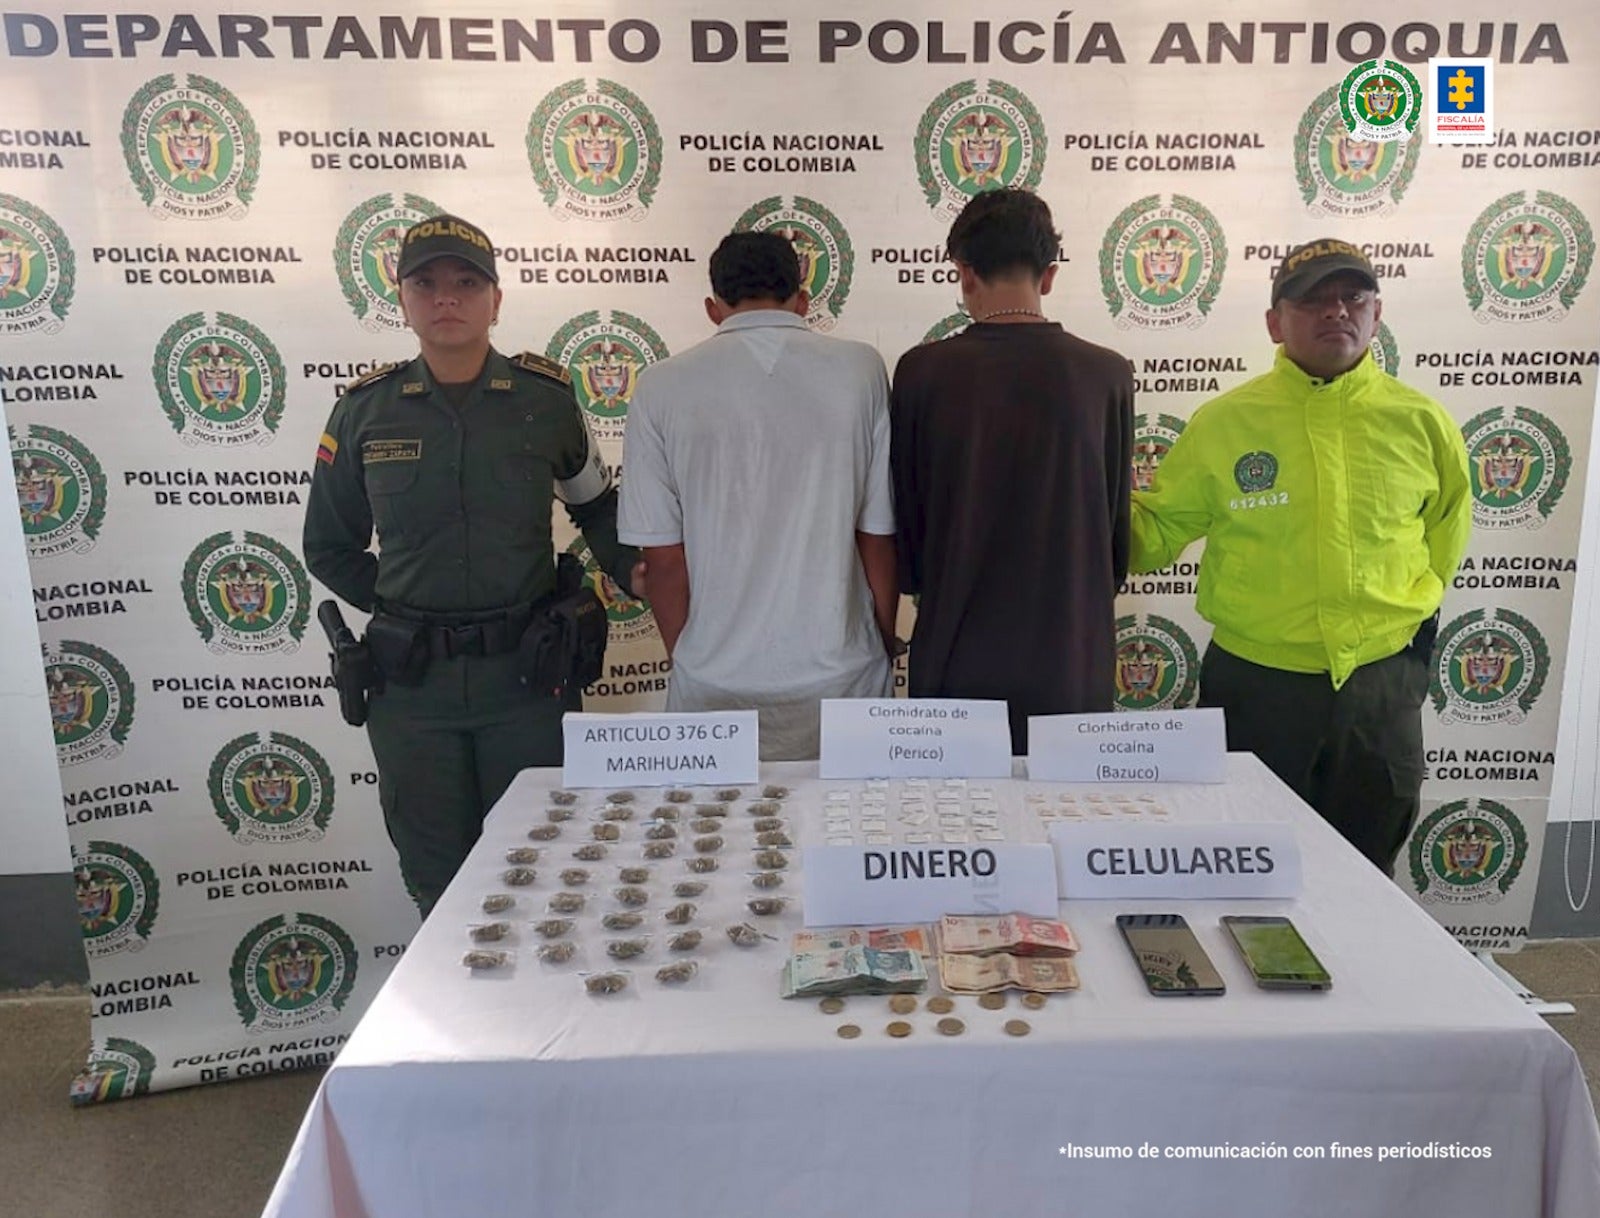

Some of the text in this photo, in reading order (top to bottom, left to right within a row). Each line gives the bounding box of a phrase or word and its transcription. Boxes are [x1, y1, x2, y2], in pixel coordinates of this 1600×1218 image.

[3, 10, 1569, 64] DEPARTAMENTO DE POLICÍA ANTIOQUIA
[0, 129, 91, 148] CIONAL
[278, 127, 495, 148] POLICÍA NACIONAL
[680, 134, 884, 151] POLICÍA NACIONAL
[1064, 133, 1265, 150] POLICÍA NACIONAL
[1523, 129, 1600, 147] NACIO
[0, 152, 64, 170] MBIA
[311, 153, 467, 170] DE COLOMBIA
[708, 157, 856, 173] DE COLOMBIA
[1091, 155, 1236, 172] DE COLOMBIA
[1461, 153, 1488, 169] DE
[92, 246, 302, 263] POLICÍA NACIONAL
[493, 243, 696, 263] POLICÍA NACIONAL
[1244, 243, 1434, 260] POLI CIONAL
[124, 268, 275, 285] DE COLOMBIA
[520, 268, 670, 284] DE COLOMBIA
[898, 269, 925, 284] DE
[304, 359, 377, 378] POLICÍ
[1143, 358, 1247, 373] NACIONAL
[1415, 352, 1599, 368] POLICÍA NACIONA
[0, 363, 123, 380] NACIONAL
[1439, 371, 1583, 387] DE COLOMBIA
[1, 385, 97, 402] LOMBIA
[123, 471, 311, 486] POLICÍA NACIONA
[154, 490, 301, 506] DE COLOMBIA
[1482, 557, 1577, 572] NACIONA
[33, 579, 153, 602] NACIONAL
[1119, 582, 1197, 594] OLOMBI
[1453, 575, 1561, 589] COLOMBIA
[36, 600, 127, 622] LOMBIA
[610, 661, 673, 678] NACIO
[152, 675, 335, 692] POLICÍA NACIONA
[583, 678, 667, 697] COLOMB
[182, 694, 325, 709] DE COLOMBIA
[868, 705, 969, 720] Clorhidrato de
[584, 724, 739, 743] ARTICULO 376 C.P
[888, 726, 943, 737] cocaína
[1077, 718, 1183, 734] Clorhidrato de
[888, 745, 944, 763] (Perico)
[1099, 740, 1155, 754] cocaína
[607, 754, 717, 772] MARIHUANA
[1465, 750, 1555, 764] NACIONA
[1096, 764, 1159, 784] (Bazuco)
[1437, 767, 1539, 780] COLOMBIA
[63, 779, 179, 806] NACIONAL
[66, 800, 153, 826] LOMBIA
[864, 848, 997, 881] DINERO
[1086, 846, 1274, 876] CELULARES
[177, 860, 373, 886] POLICÍA NACIONAL
[207, 877, 349, 900] DE COLOMBIA
[1445, 926, 1527, 937] NACIONA
[173, 1033, 350, 1069] POLICÍA NACION
[201, 1052, 334, 1083] DE COLOMBI
